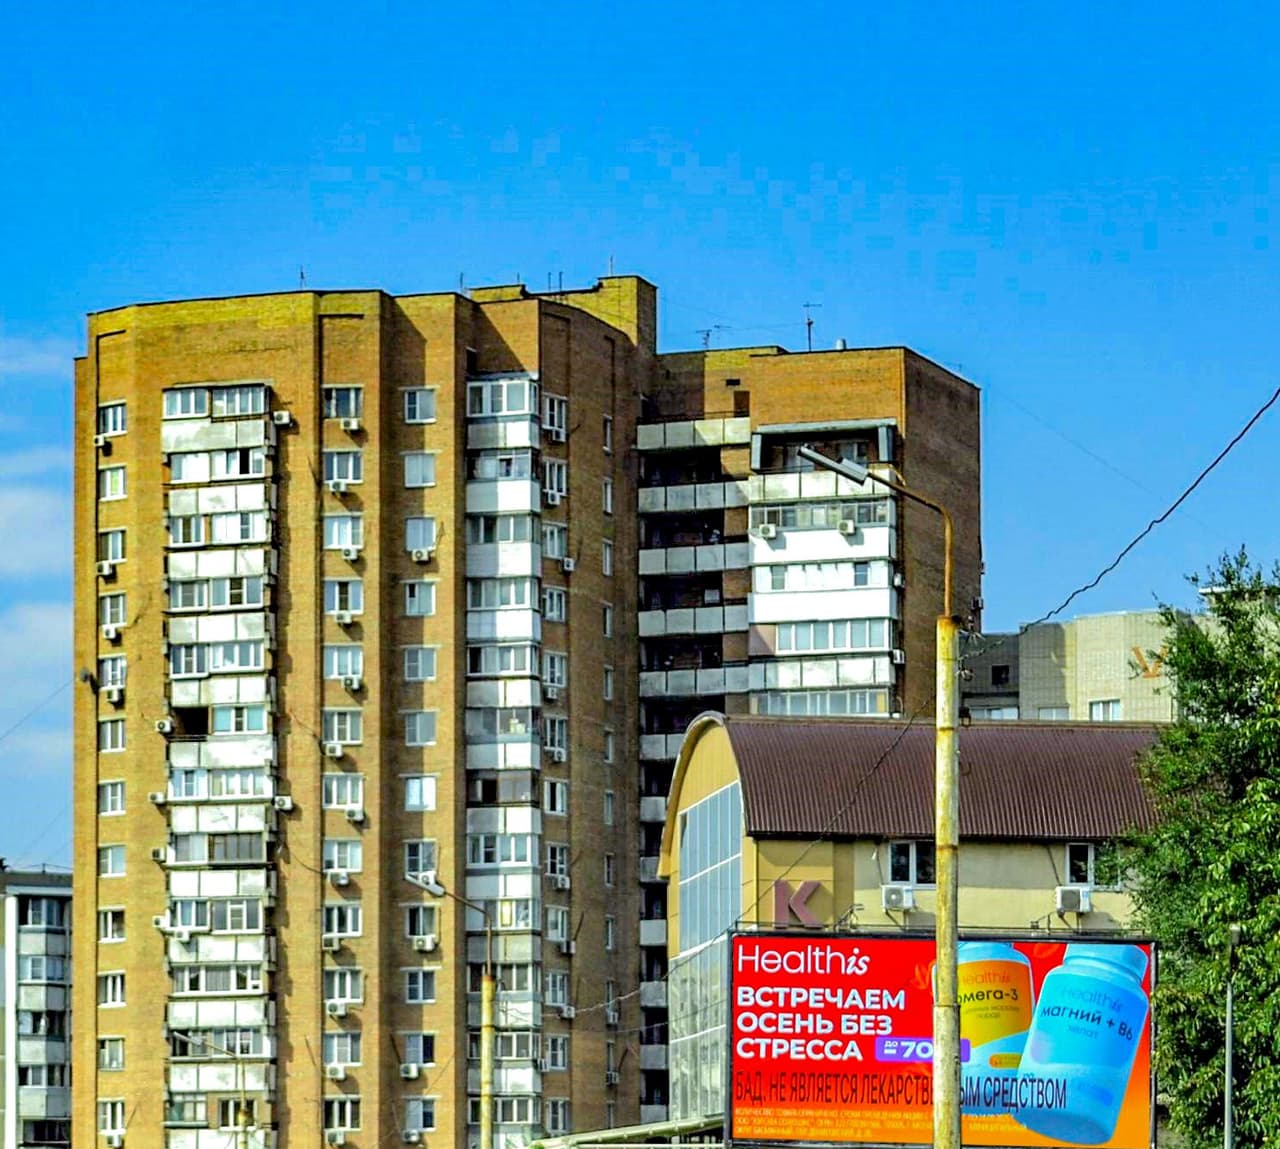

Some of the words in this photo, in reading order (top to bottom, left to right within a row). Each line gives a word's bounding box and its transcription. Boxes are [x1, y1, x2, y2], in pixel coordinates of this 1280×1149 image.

[737, 944, 870, 976] Healthis
[737, 986, 906, 1011] ВСТРЕЧАЕМ
[736, 1012, 835, 1035] ОСЕНЬ
[840, 1014, 893, 1036] БЕЗ
[1040, 1005, 1102, 1025] магний
[736, 1037, 863, 1061] СТРЕССА
[736, 1071, 766, 1106] БАД.
[770, 1072, 786, 1102] НЕ
[790, 1072, 858, 1104] ЯВЛЯЕТСЯ
[983, 1076, 1067, 1113] СРЕДСТВОМ
